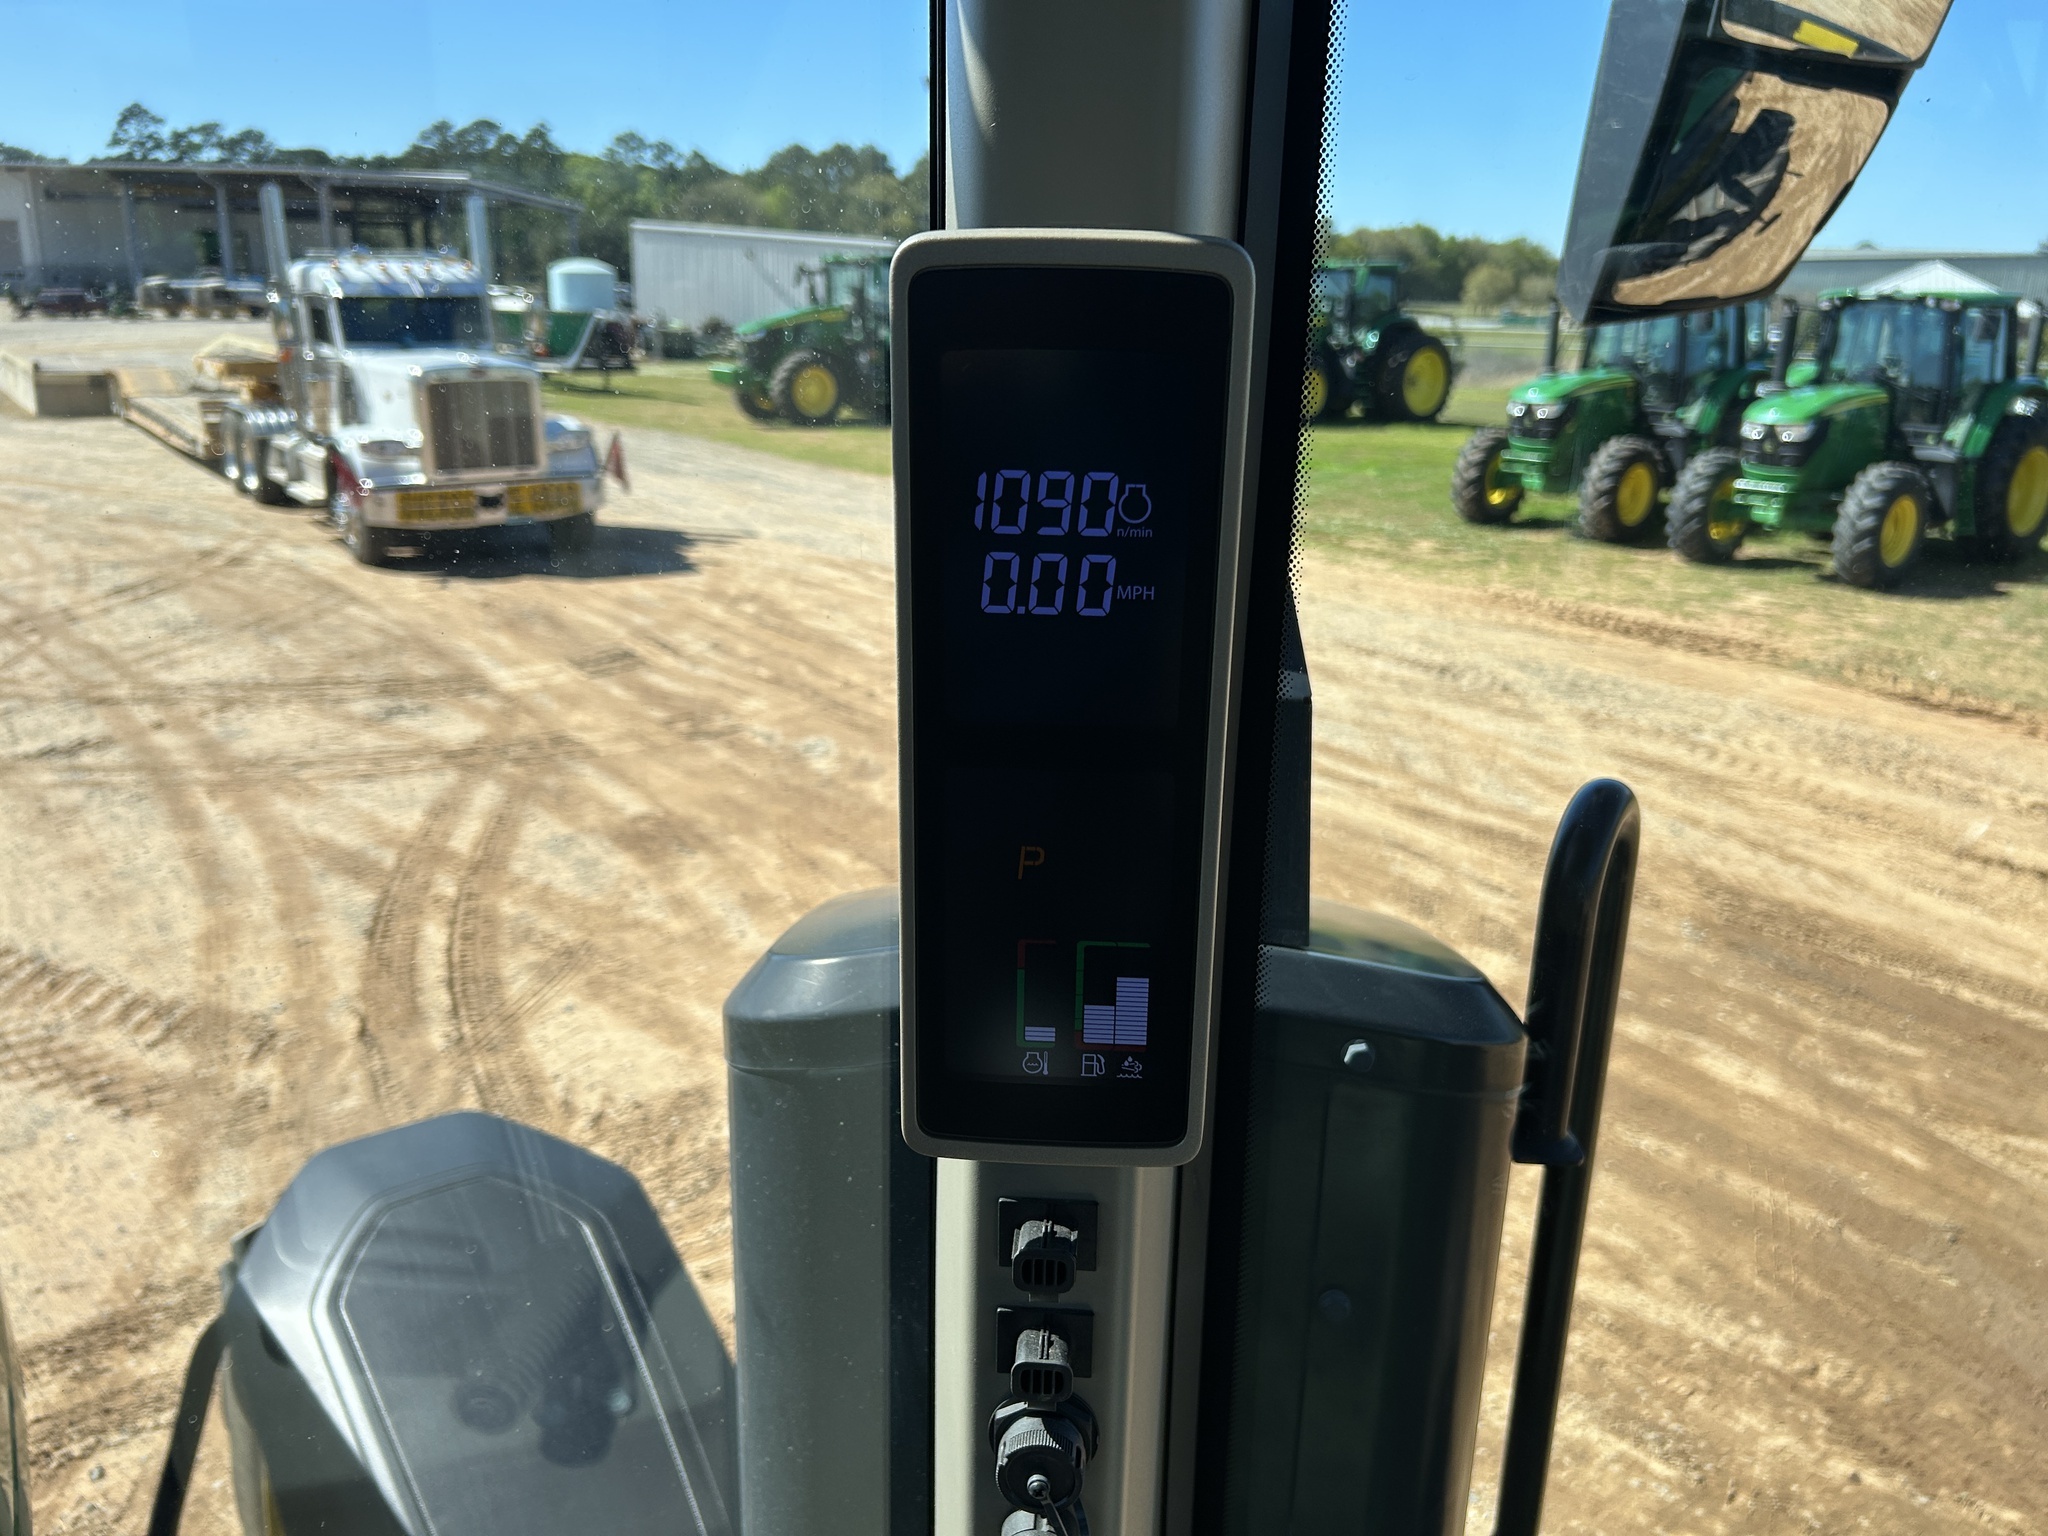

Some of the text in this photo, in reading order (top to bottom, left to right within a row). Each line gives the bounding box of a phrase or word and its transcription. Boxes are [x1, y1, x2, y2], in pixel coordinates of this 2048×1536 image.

[974, 469, 1119, 537] 1090
[1116, 526, 1153, 538] n/min
[981, 551, 1155, 617] 0.00 MPH
[1017, 845, 1045, 880] P
